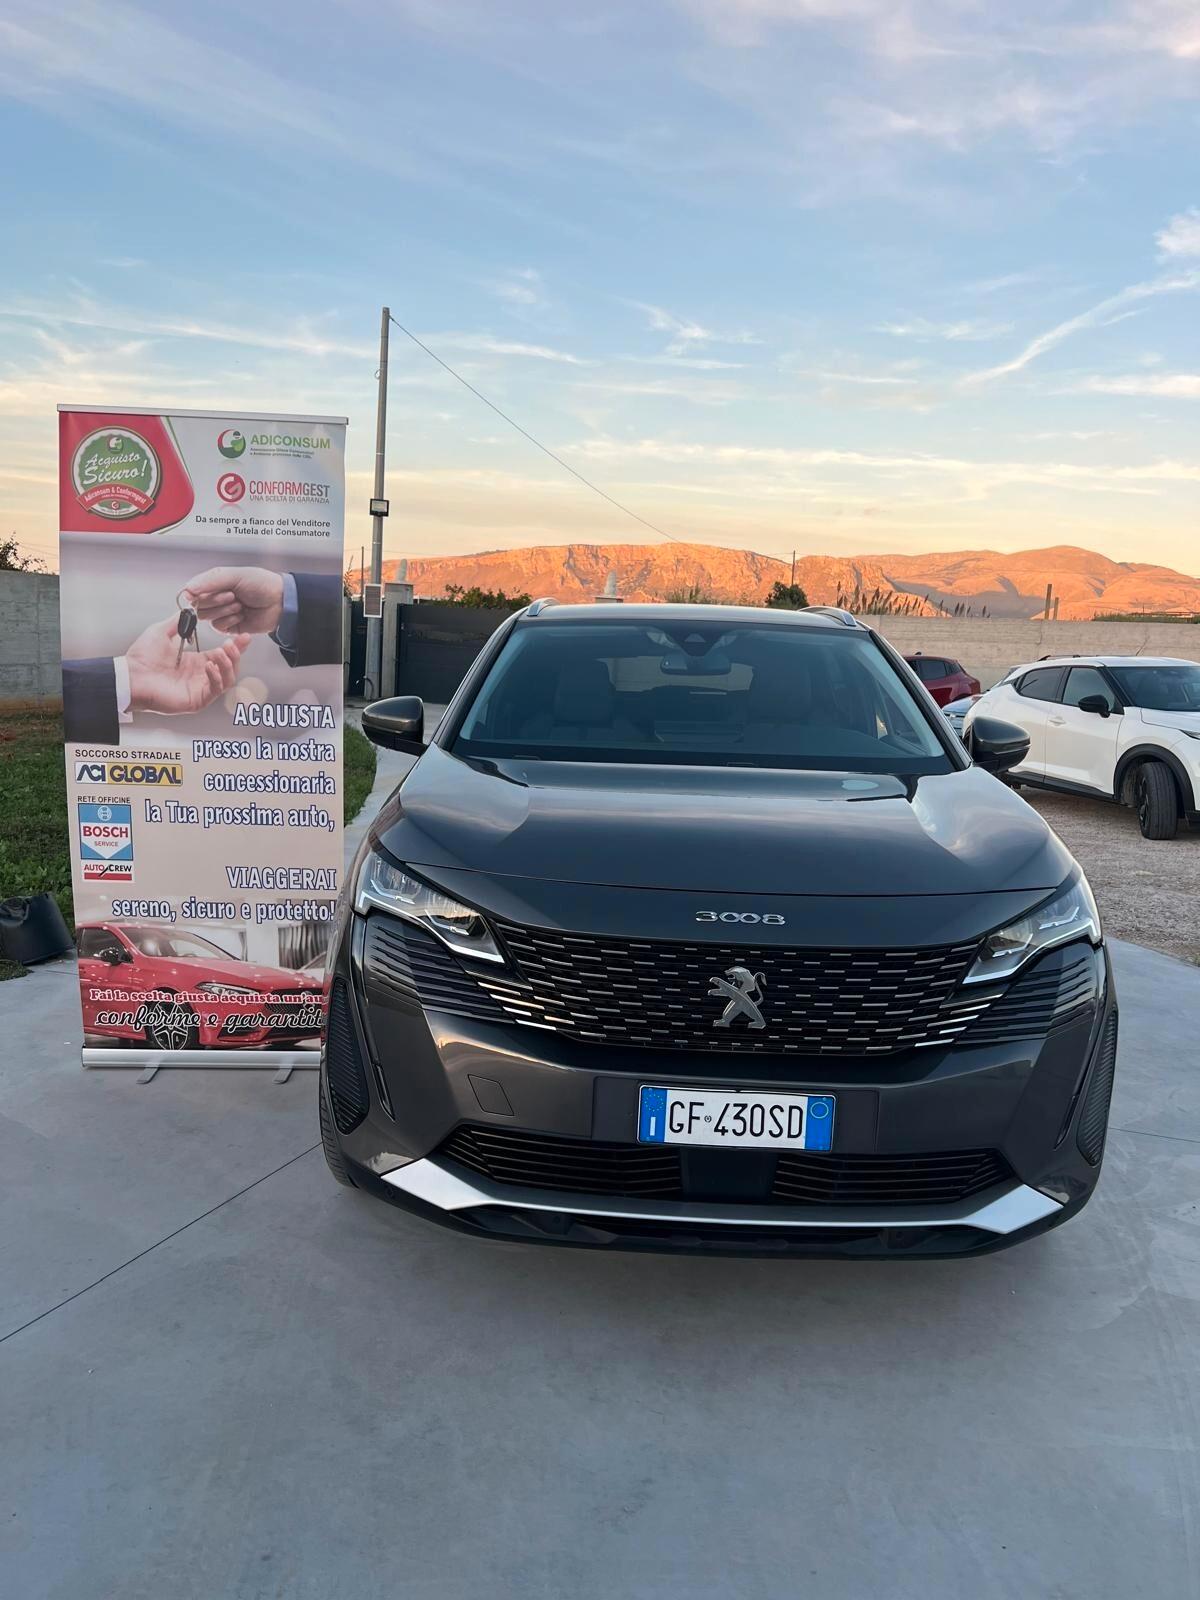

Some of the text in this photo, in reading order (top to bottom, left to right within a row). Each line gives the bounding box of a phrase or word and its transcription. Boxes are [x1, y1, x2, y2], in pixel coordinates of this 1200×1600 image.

[250, 434, 330, 449] ADICONSUM
[85, 452, 140, 469] Acquisto
[83, 459, 148, 485] Sicuro!
[249, 480, 330, 497] CONFORMGEST
[297, 496, 330, 504] GARANZIA
[195, 515, 207, 523] Da
[209, 517, 240, 526] sempre
[249, 517, 274, 526] fianco
[276, 518, 289, 526] del
[291, 518, 331, 528] Venditore
[234, 526, 258, 535] Tutela
[261, 526, 273, 535] del
[275, 527, 330, 537] Consumatore
[233, 702, 335, 728] ACQUISTA
[75, 749, 181, 760] SOCCORSO STRADALE
[192, 736, 335, 762] presso la nostra
[76, 764, 181, 784] ACI GLOBAL
[204, 769, 335, 795] concessionaria
[77, 795, 96, 803] RETE
[144, 798, 335, 832] la Tua prossima auto,
[82, 825, 129, 838] BOSCH
[108, 864, 132, 872] CREW
[225, 866, 337, 890] VIAGGERAI
[112, 896, 336, 924] sereno, sicuro e protetto!
[695, 910, 786, 925] 3008
[89, 989, 323, 1005] Fai la scelta giusta acquista un'au
[95, 1004, 322, 1033] conforme e garantit
[668, 1100, 705, 1134] GF
[713, 1102, 804, 1139] 430SD
